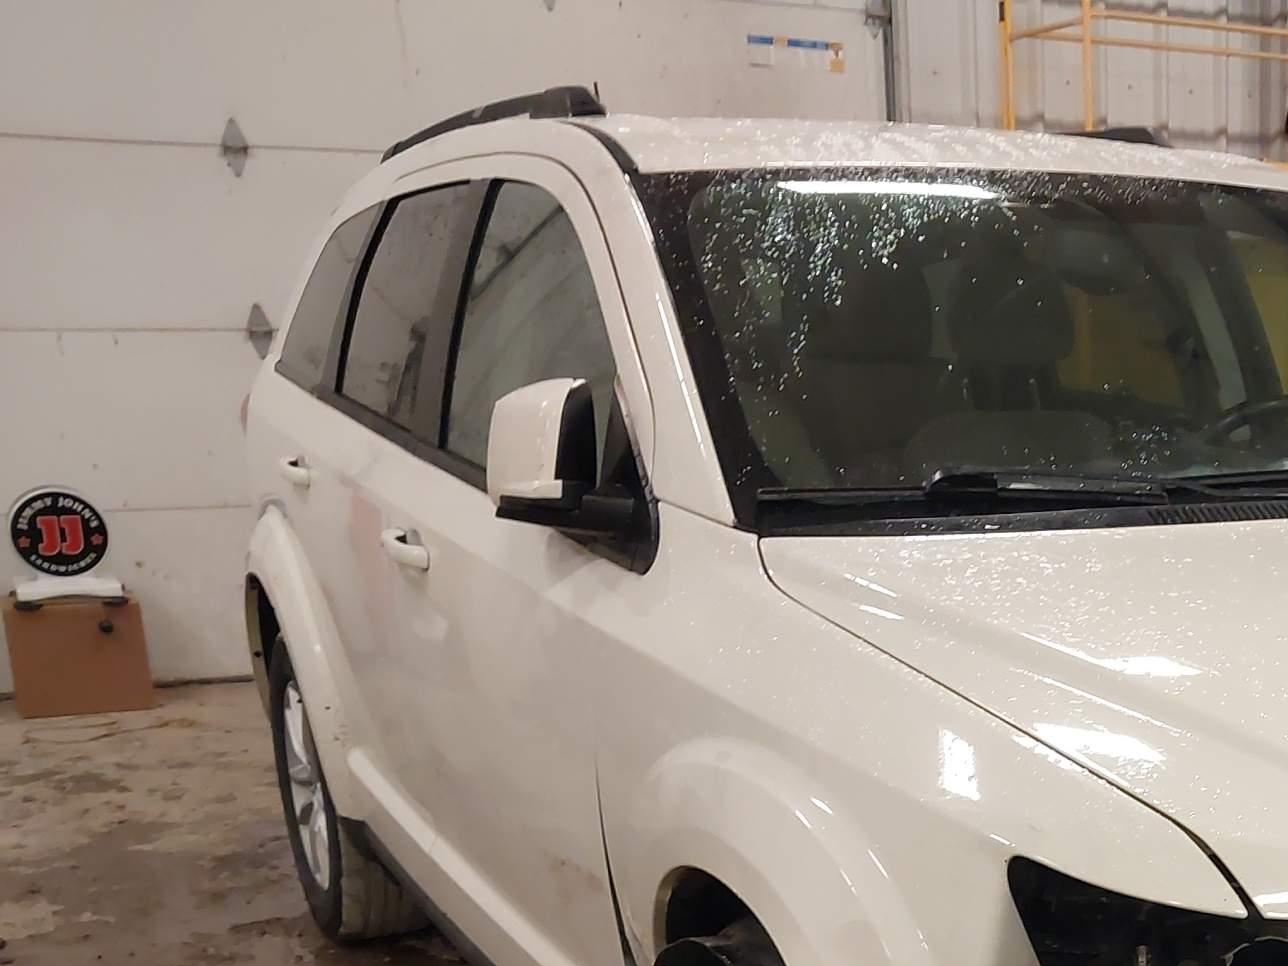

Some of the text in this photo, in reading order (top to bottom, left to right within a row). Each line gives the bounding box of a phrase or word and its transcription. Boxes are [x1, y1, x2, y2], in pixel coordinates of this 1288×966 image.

[16, 496, 100, 530] JIMMY JOHN'S
[36, 514, 85, 556] JJ
